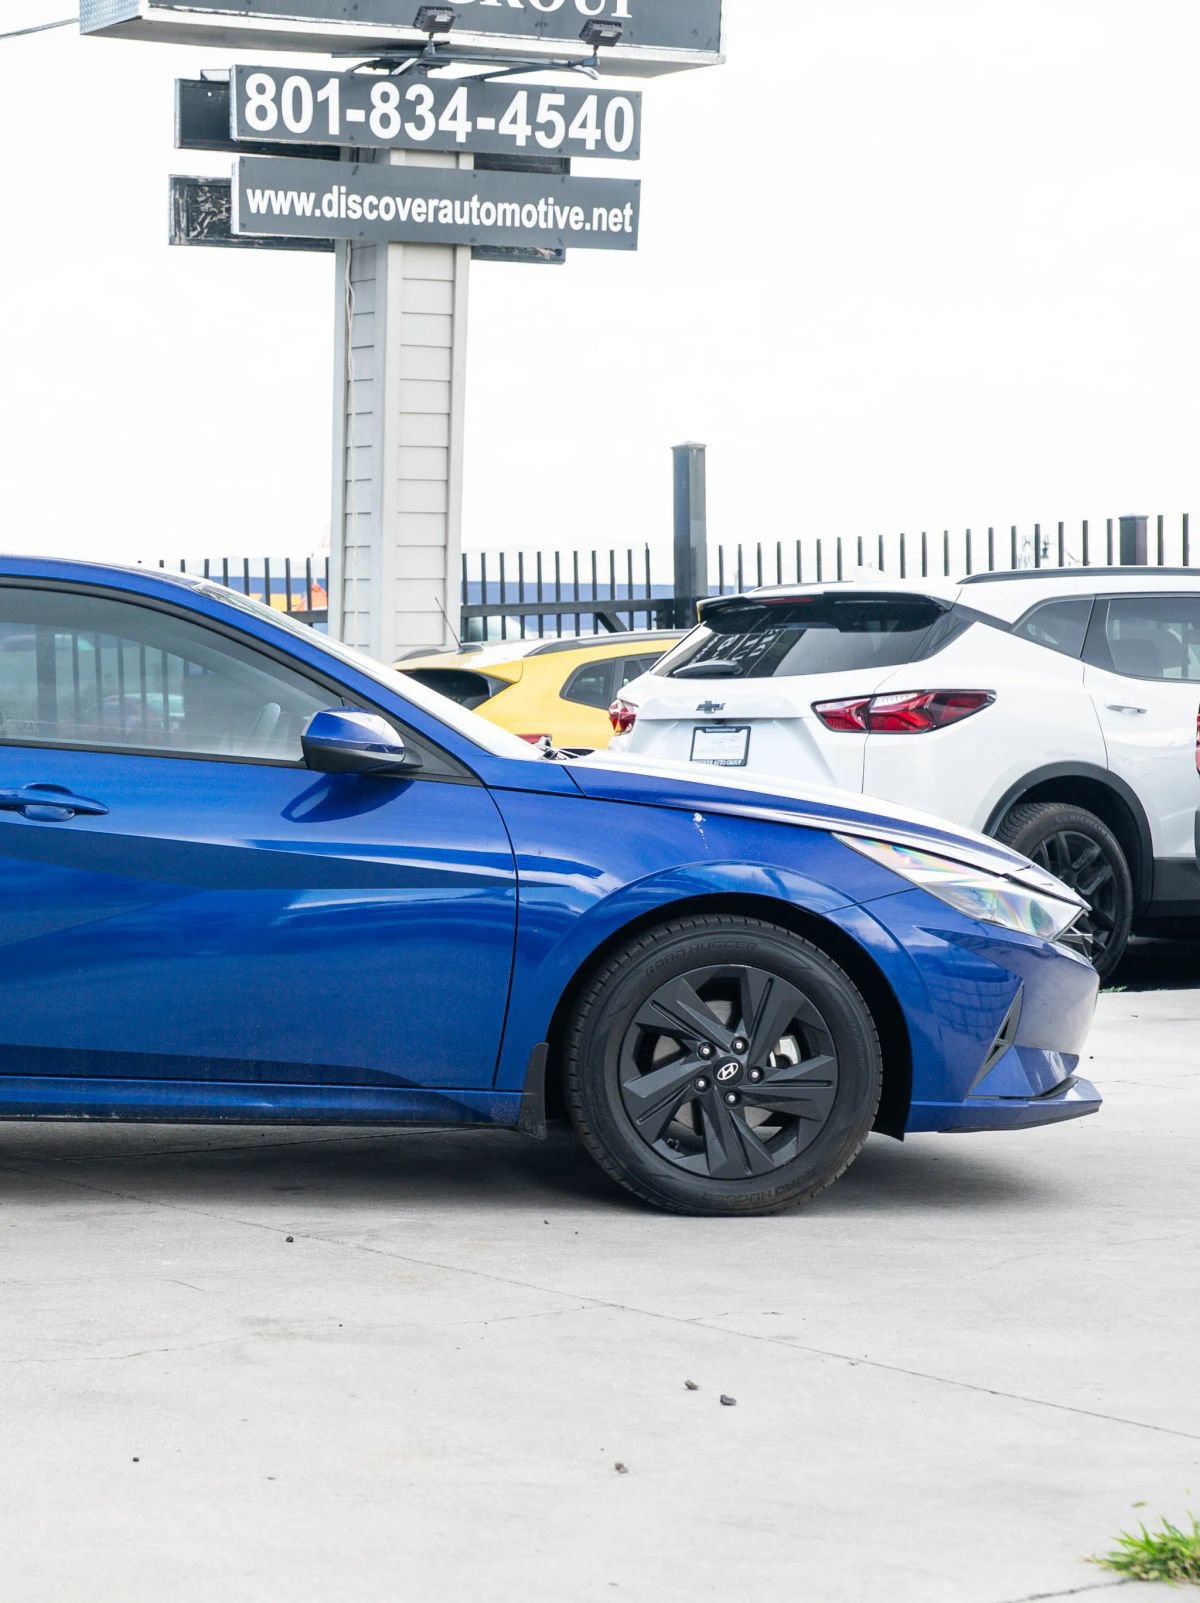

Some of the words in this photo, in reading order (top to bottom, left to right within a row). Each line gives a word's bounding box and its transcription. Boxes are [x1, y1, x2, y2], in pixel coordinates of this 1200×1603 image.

[245, 73, 634, 152] 801-834-4540
[246, 185, 633, 232] www.discoverautomotive.net
[689, 940, 760, 953] HUGGER
